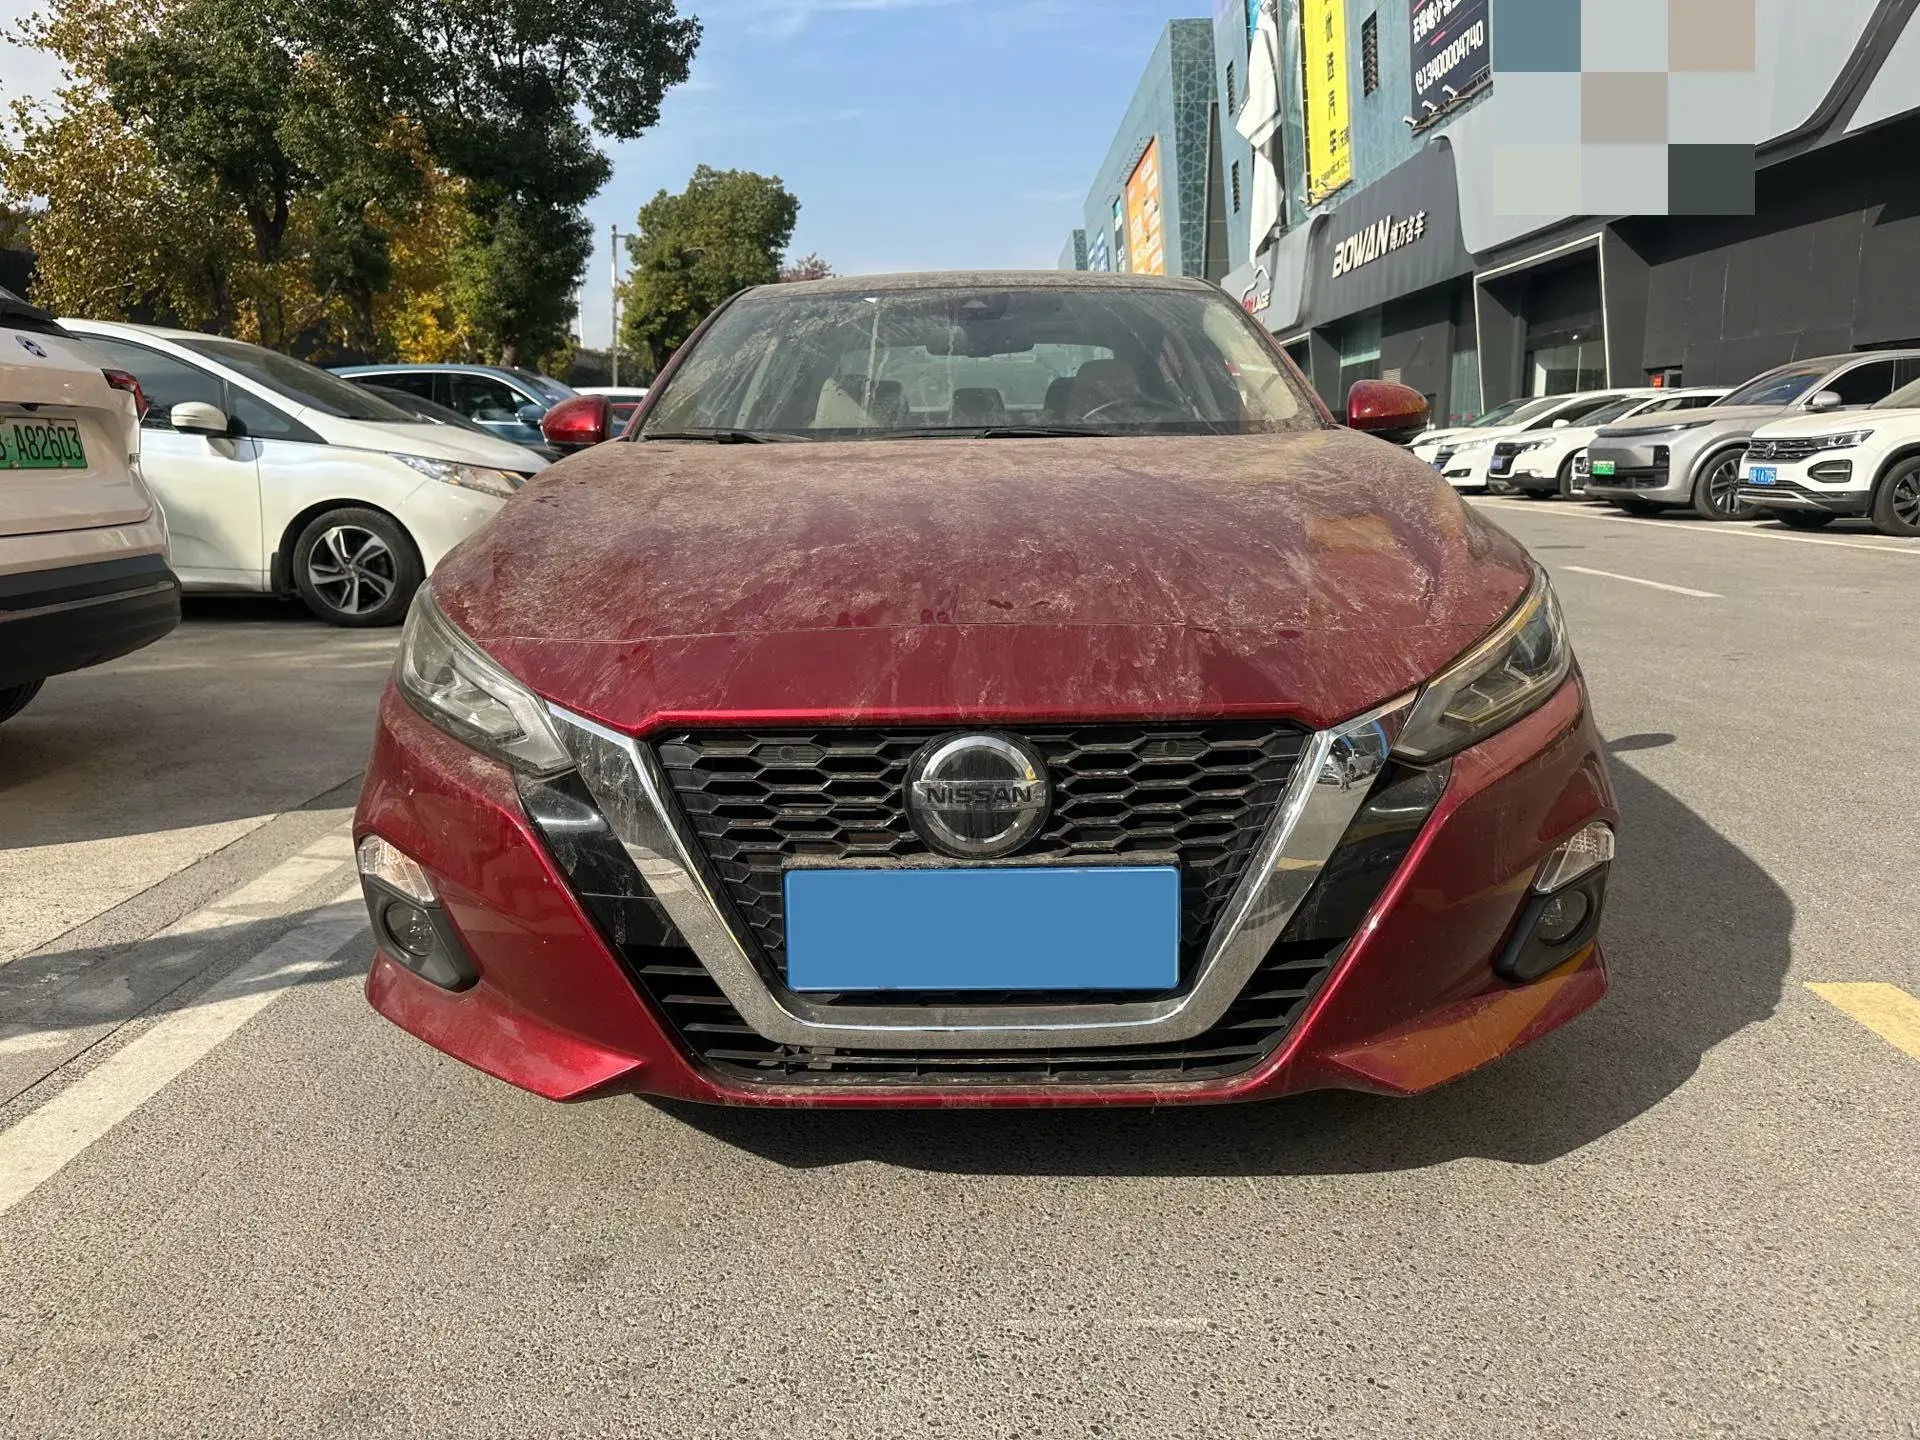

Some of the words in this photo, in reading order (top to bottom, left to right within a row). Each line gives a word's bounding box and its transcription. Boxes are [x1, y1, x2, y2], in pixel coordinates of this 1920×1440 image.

[1421, 20, 1484, 90] 13400004740
[1332, 215, 1391, 279] BOWAN
[926, 785, 1032, 805] NISSAN
